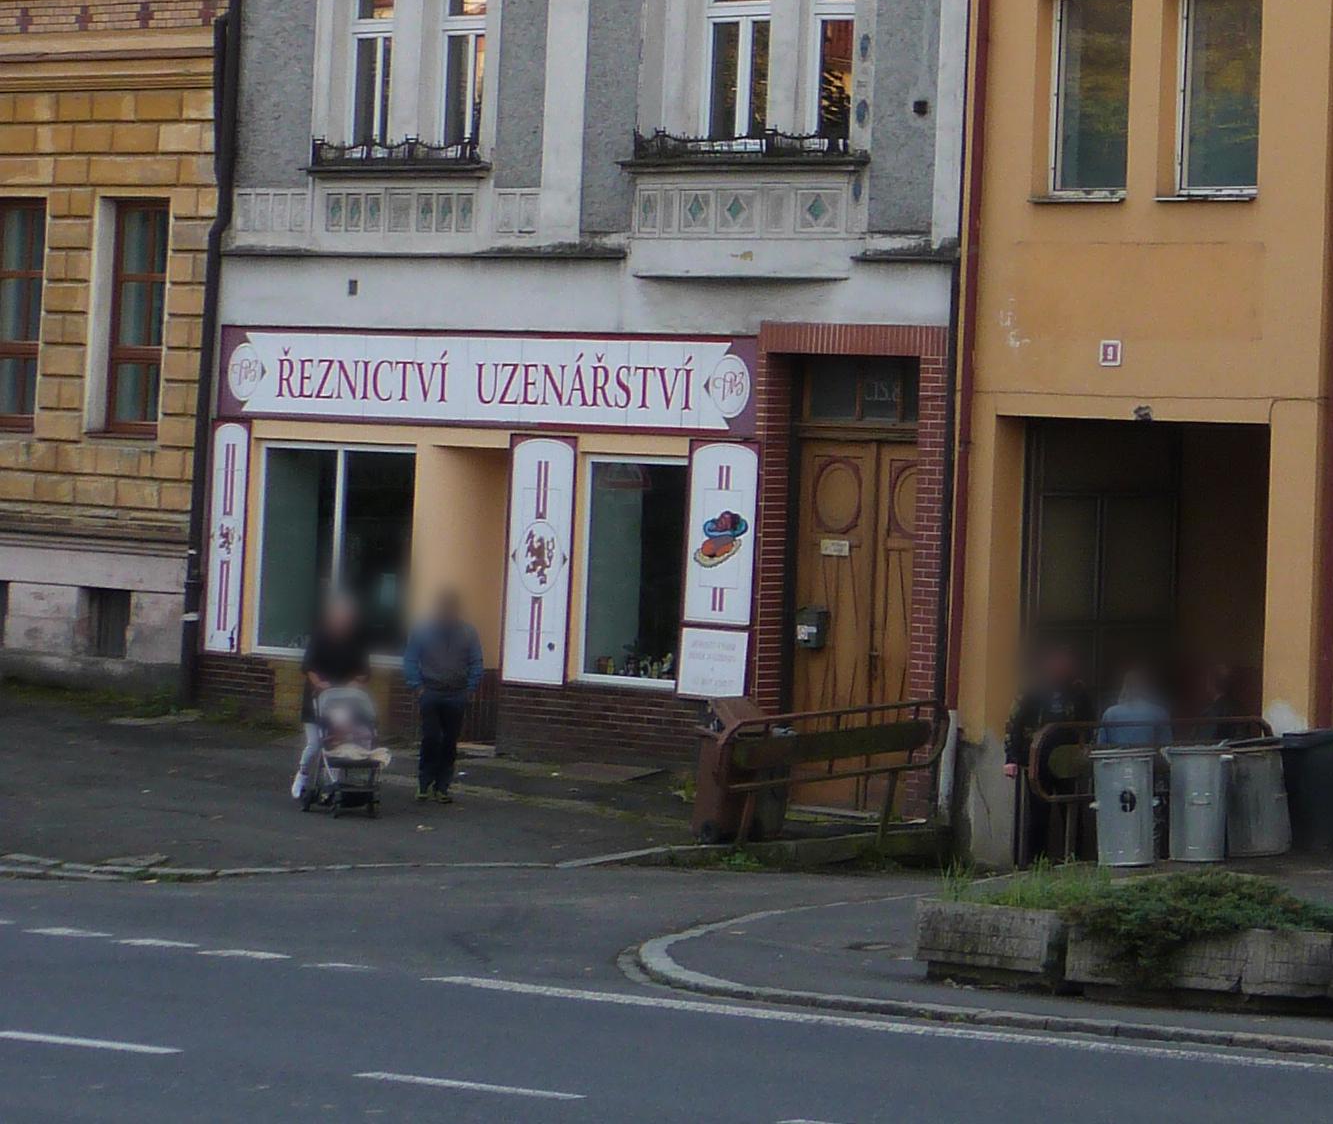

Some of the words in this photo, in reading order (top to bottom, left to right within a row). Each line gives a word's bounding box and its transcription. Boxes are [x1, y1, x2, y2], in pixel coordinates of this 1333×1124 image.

[275, 346, 449, 404] ŘEZNICTVÍ
[475, 352, 694, 412] UZENÁŘSTVÍ
[1119, 789, 1137, 813] 9
